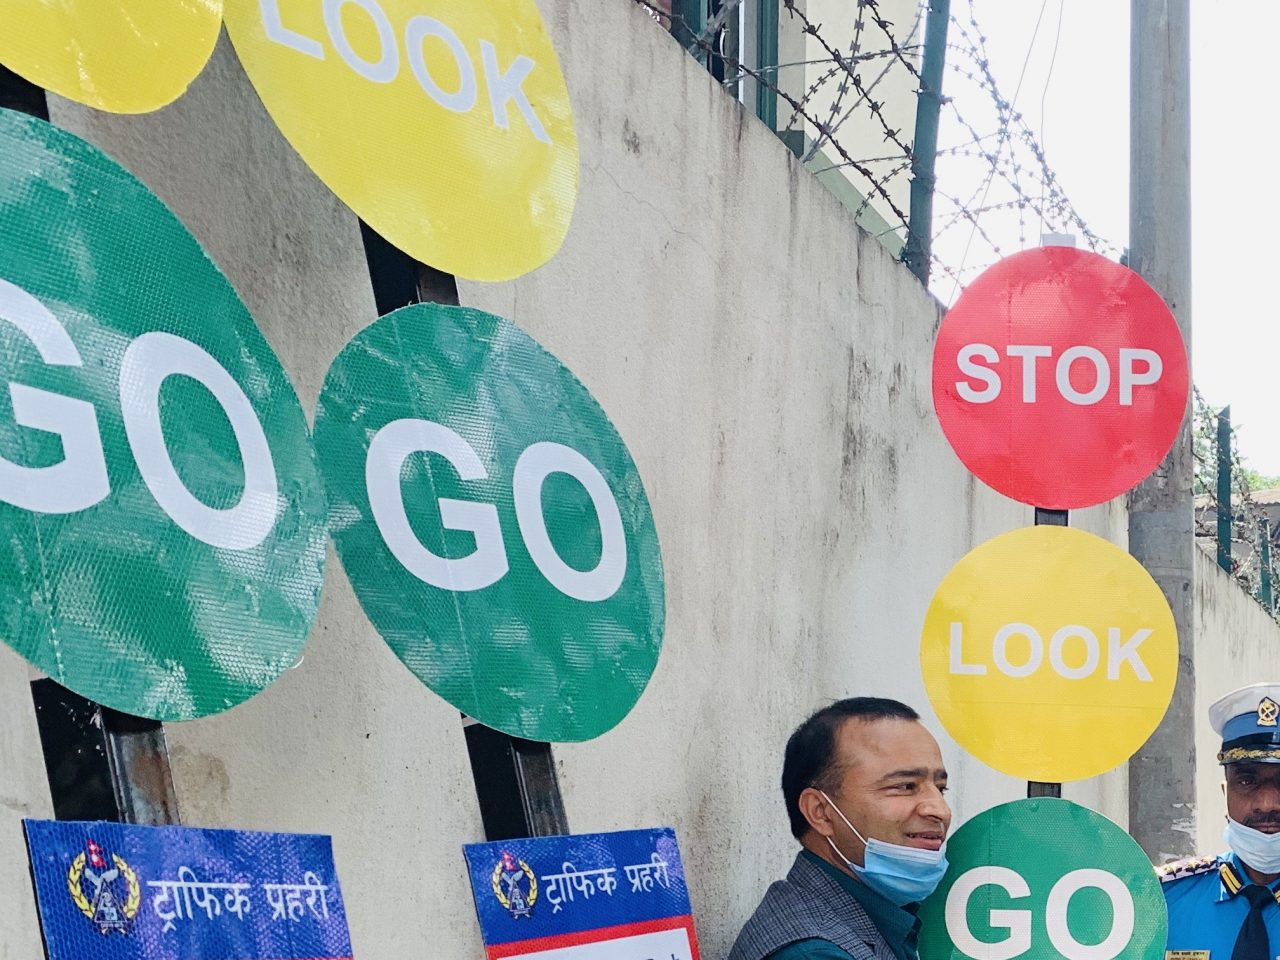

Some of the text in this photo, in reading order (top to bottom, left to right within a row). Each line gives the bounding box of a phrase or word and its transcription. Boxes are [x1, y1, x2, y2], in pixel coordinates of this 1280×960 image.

[260, 0, 553, 144] LOOK
[955, 343, 1163, 406] STOP
[0, 278, 278, 550] GO
[365, 418, 627, 601] GO
[949, 622, 1154, 682] LOOK
[147, 866, 328, 933] ट्राफिक प्रहरी
[541, 852, 669, 914] ट्राफिक प्रहरी
